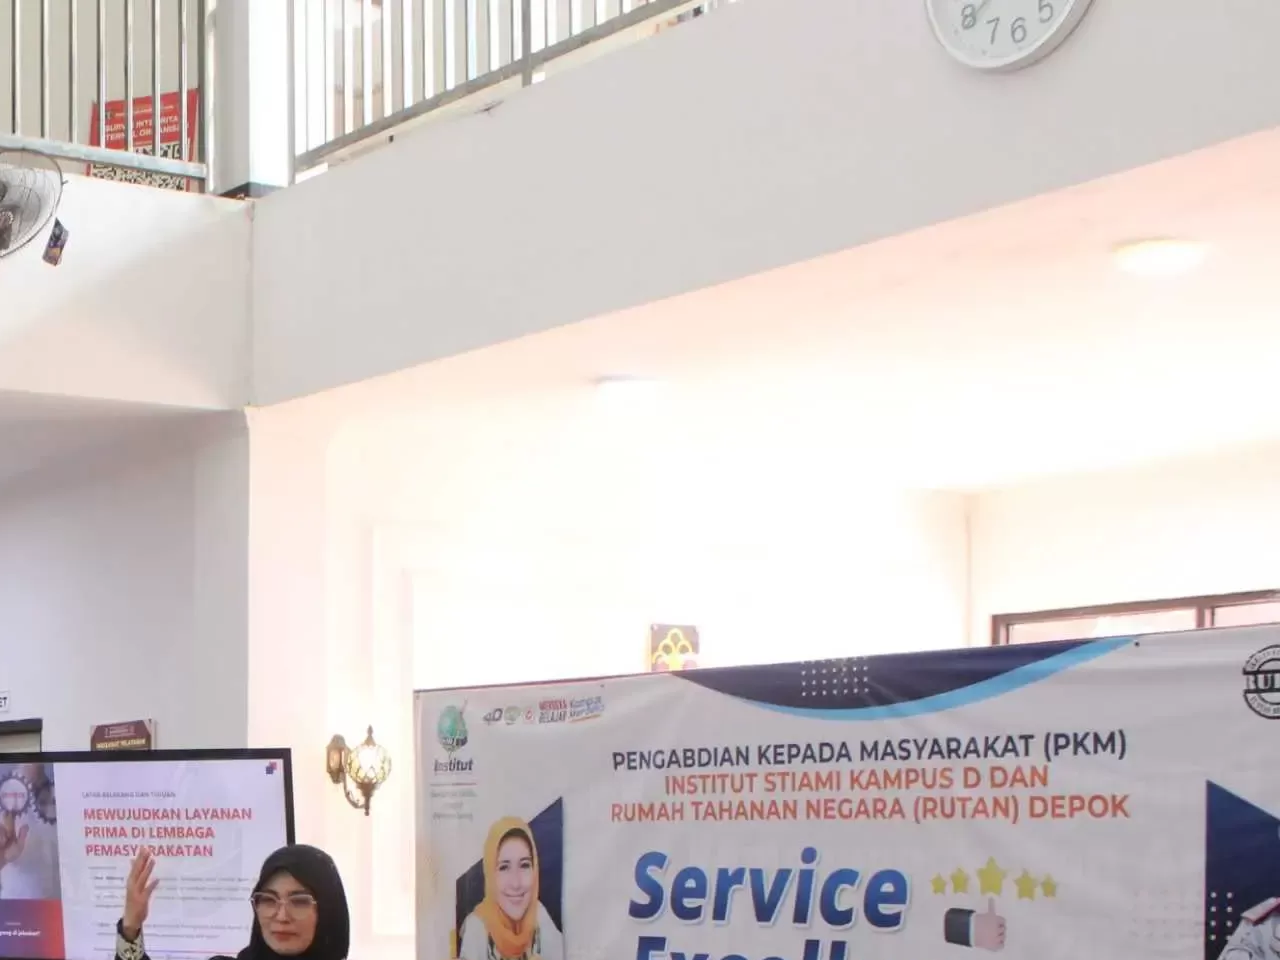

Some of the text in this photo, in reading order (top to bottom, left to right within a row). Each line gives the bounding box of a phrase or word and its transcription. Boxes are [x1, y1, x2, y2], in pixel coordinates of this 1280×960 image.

[961, 5, 977, 30] 8
[1038, 0, 1053, 23] 5
[986, 17, 1000, 45] 7
[1010, 17, 1027, 43] 6
[613, 729, 1127, 772] PENGABDIAN KEPADA MASYARAKAT (PKM)
[665, 765, 1049, 795] INSTITUT STIAMI KAMPUS D DAN
[83, 807, 252, 821] MEWUJUDKAN LAYANAN
[611, 794, 1130, 824] RUMAH TAHANAN NEGARA (RUTAN) DEPOK
[84, 826, 216, 839] PRIMA DI LEMBAGA
[629, 847, 910, 927] Service
